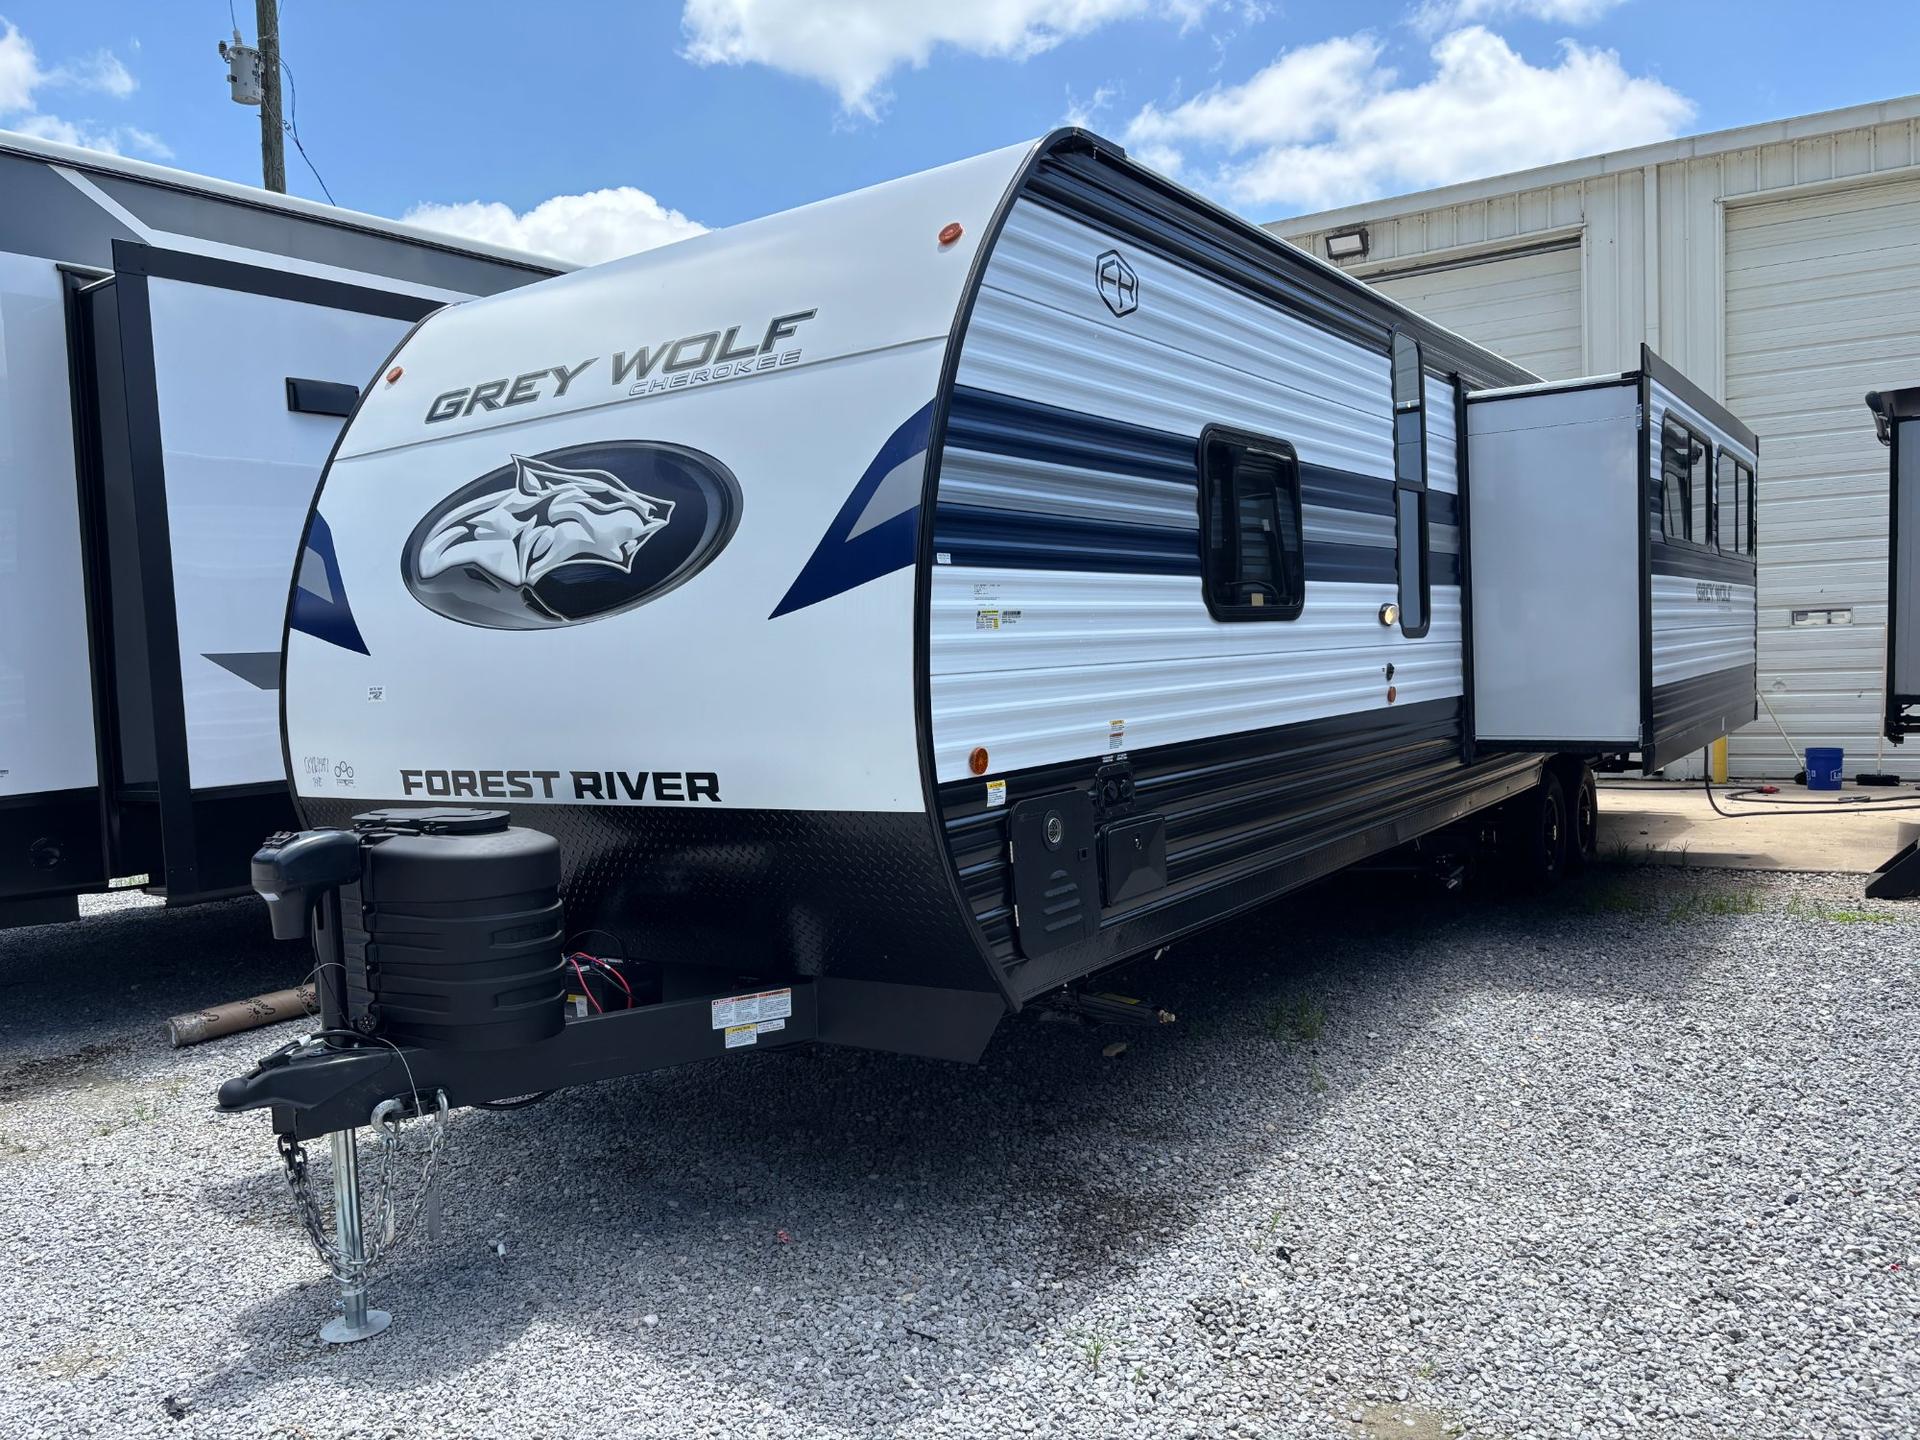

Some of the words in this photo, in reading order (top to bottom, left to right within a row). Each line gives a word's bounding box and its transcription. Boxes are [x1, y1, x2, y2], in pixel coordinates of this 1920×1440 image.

[425, 356, 600, 424] GREY
[611, 308, 818, 386] WOLF
[628, 348, 803, 396] CHEROKEE
[400, 769, 560, 799] FOREST
[569, 771, 722, 802] RIVER
